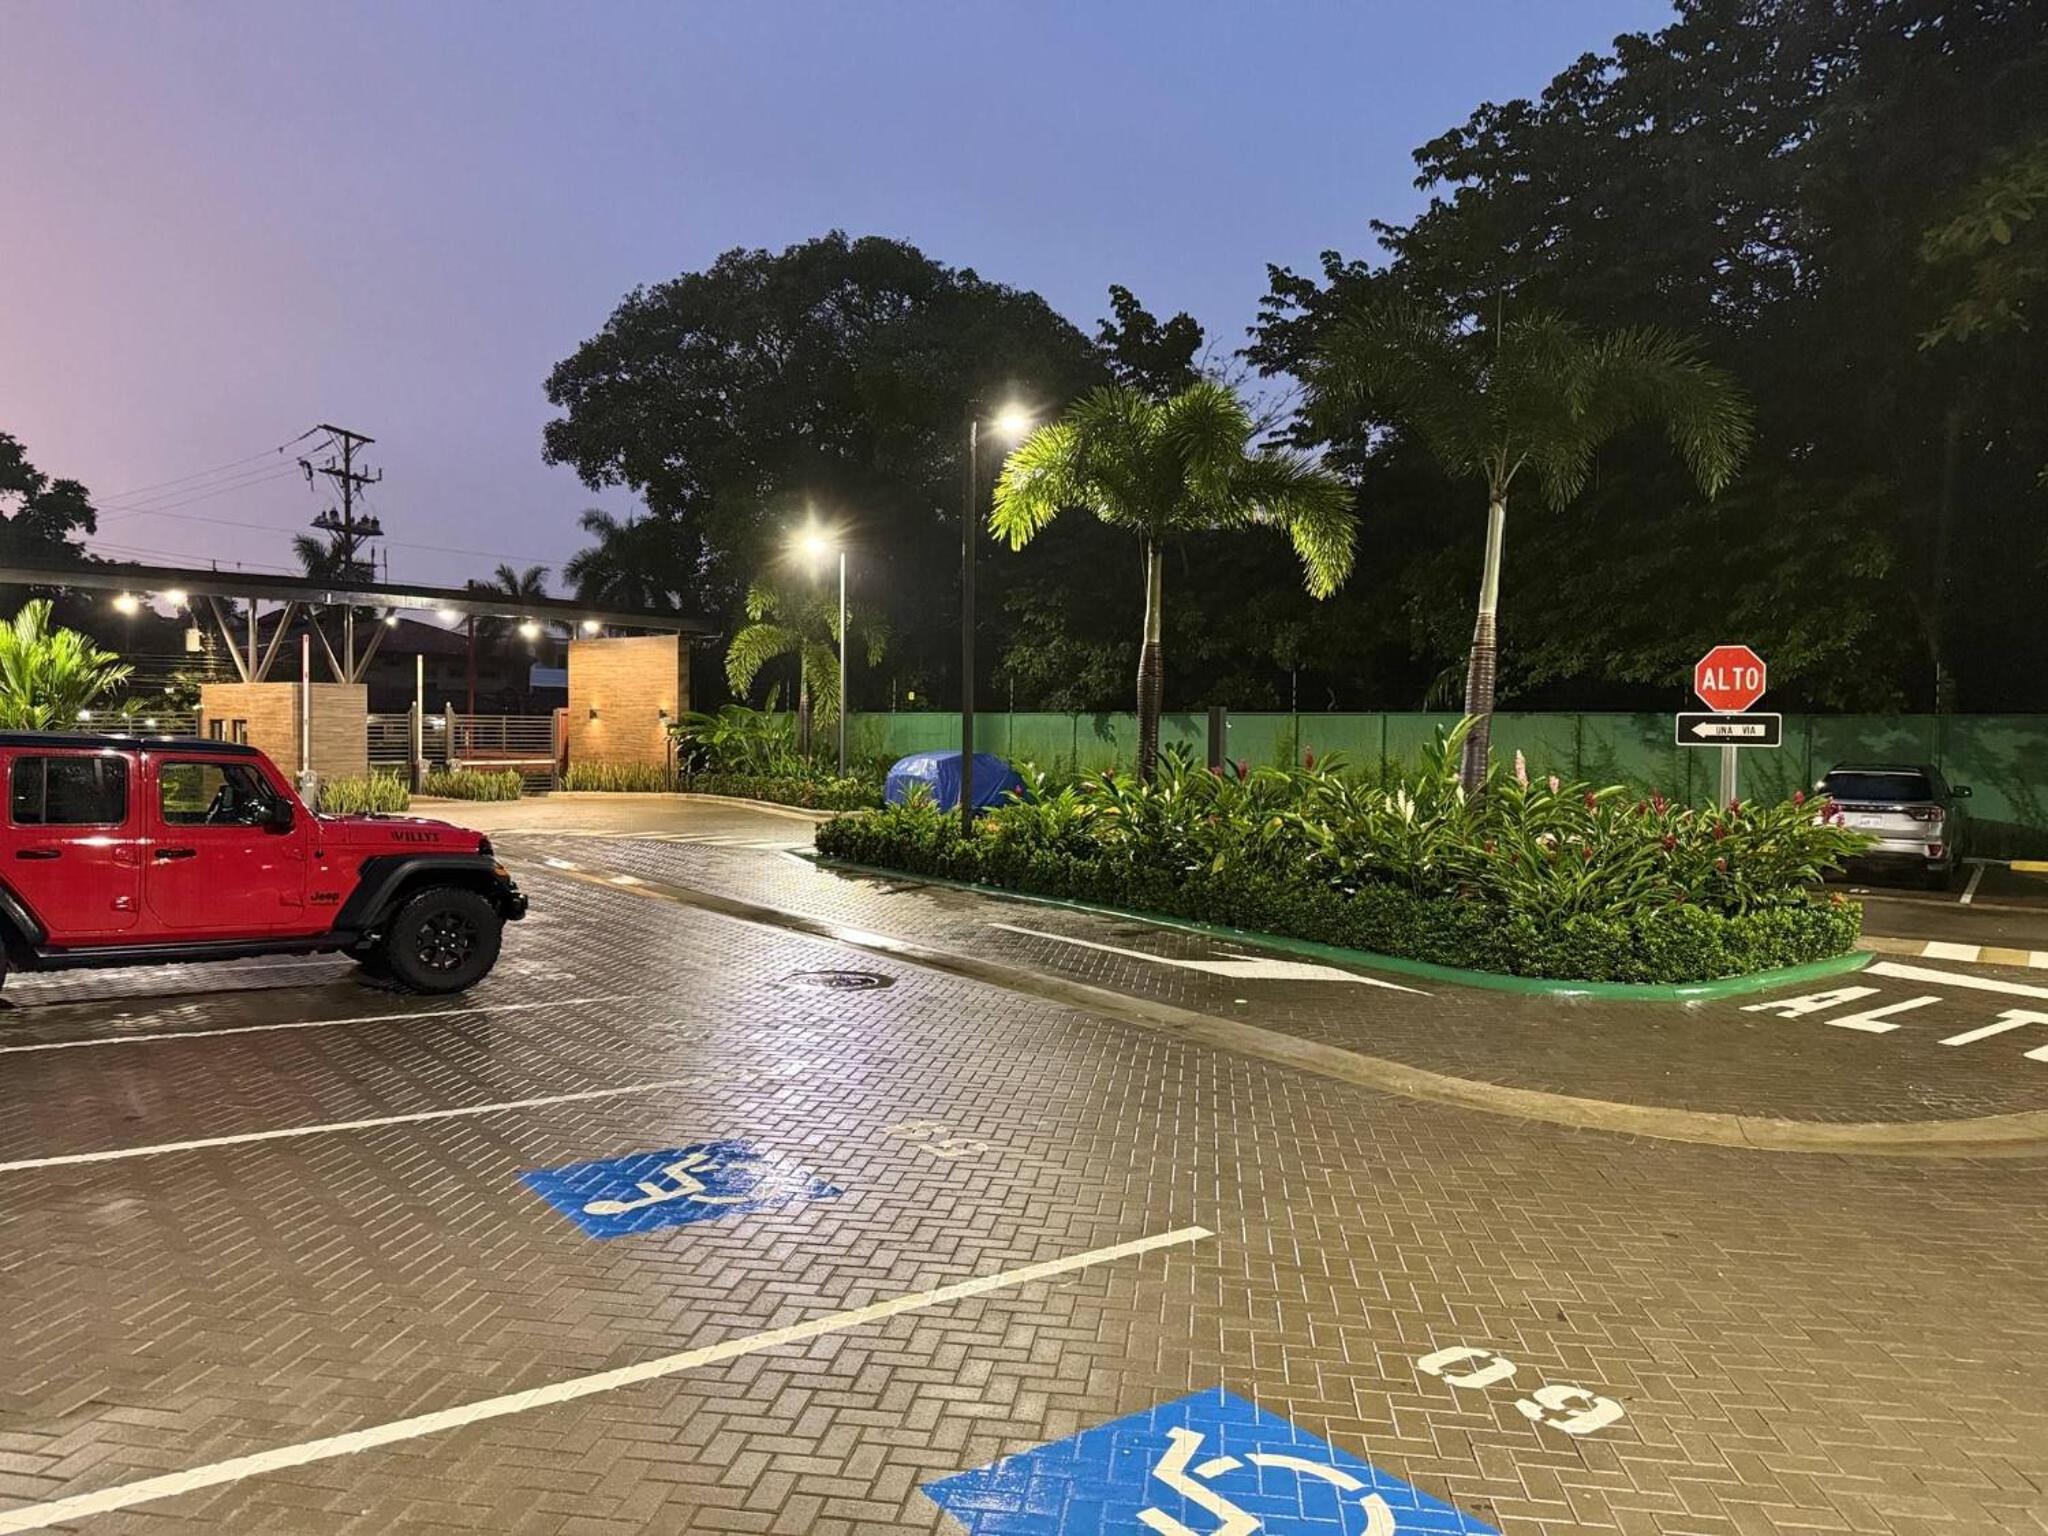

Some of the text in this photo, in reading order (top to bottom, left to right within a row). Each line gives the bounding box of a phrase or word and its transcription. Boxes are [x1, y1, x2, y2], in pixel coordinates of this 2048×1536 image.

[1702, 667, 1760, 691] ALTO
[1741, 726, 1757, 735] VIA
[310, 891, 340, 903] Jeep
[1739, 986, 2048, 1062] ALT
